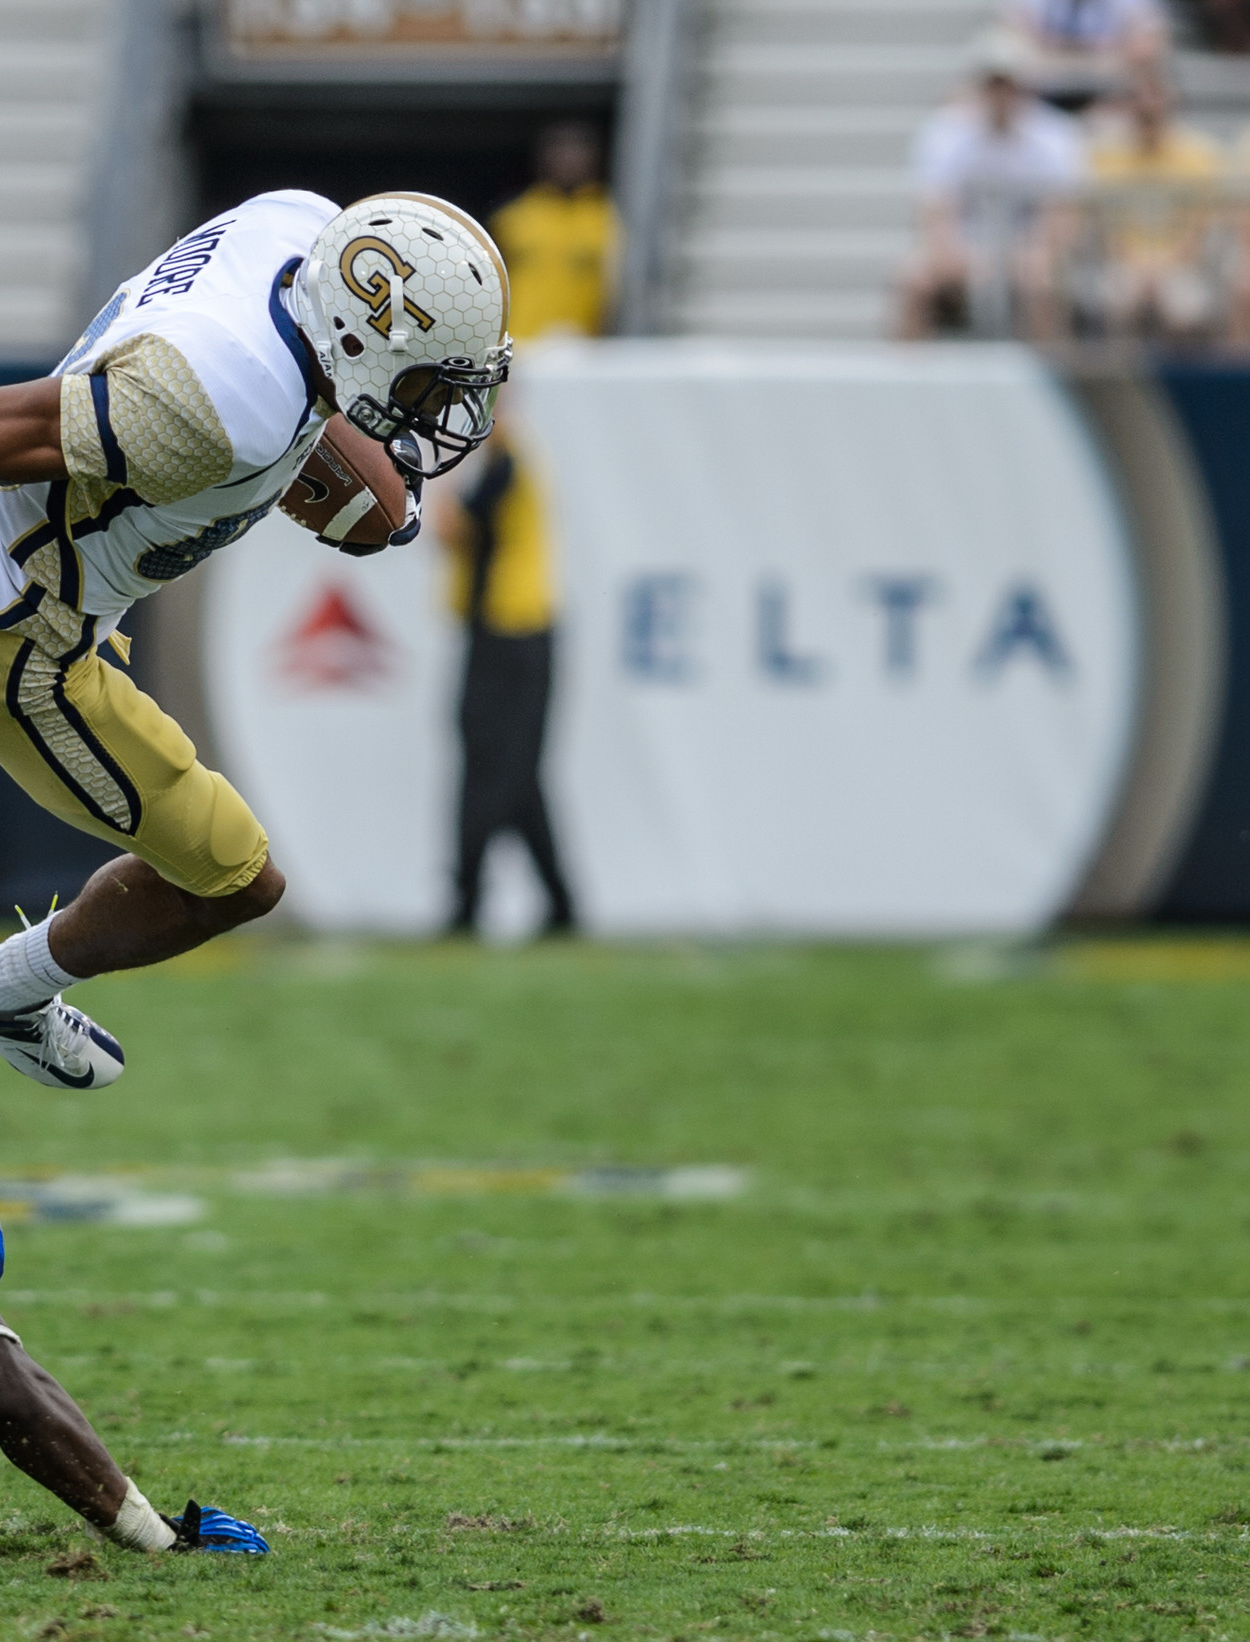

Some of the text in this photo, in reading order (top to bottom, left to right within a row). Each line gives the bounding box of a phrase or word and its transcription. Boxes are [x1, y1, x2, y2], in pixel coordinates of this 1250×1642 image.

[339, 235, 436, 340] GT
[314, 441, 352, 487] VAPOR
[620, 570, 1076, 690] ELTA
